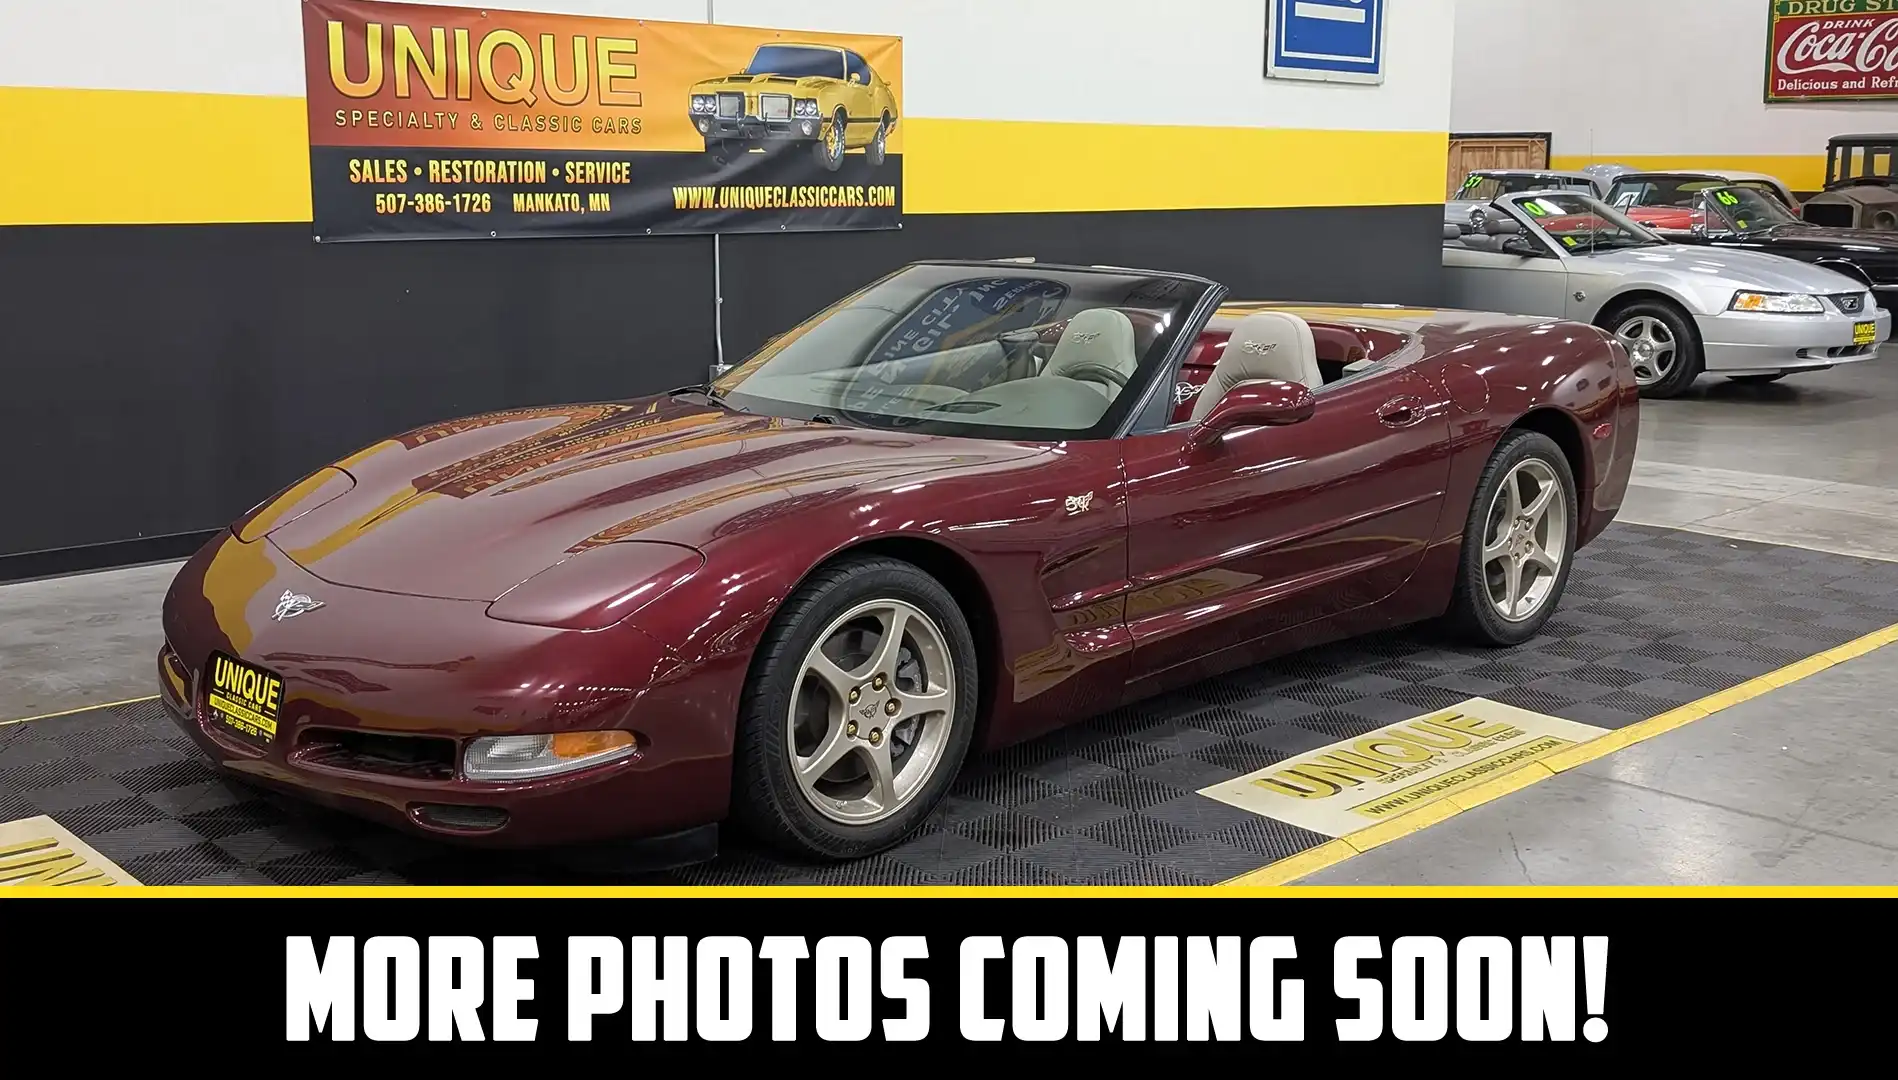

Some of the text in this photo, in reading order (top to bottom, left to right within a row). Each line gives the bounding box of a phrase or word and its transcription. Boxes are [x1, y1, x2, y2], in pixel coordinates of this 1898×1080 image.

[1788, 0, 1856, 15] DRUG
[1822, 19, 1876, 30] DRINK
[326, 19, 643, 108] UNIQUE
[1777, 79, 1838, 91] Delicious
[1842, 76, 1866, 89] and
[335, 109, 643, 135] SPECIALTY & CLASSIC CARS
[349, 159, 631, 184] SALES RESTORATION SERVICE
[375, 192, 611, 215] 507-386-1726 MANKATO, MN
[672, 185, 895, 210] WWW.UNIQUECLASSICCARS.COM
[1716, 191, 1738, 206] 66
[215, 657, 280, 710] UNIQUE
[1250, 710, 1516, 801] UNIQUE
[1365, 739, 1563, 815] WWW.UNIQUECLASSICCARS.COM
